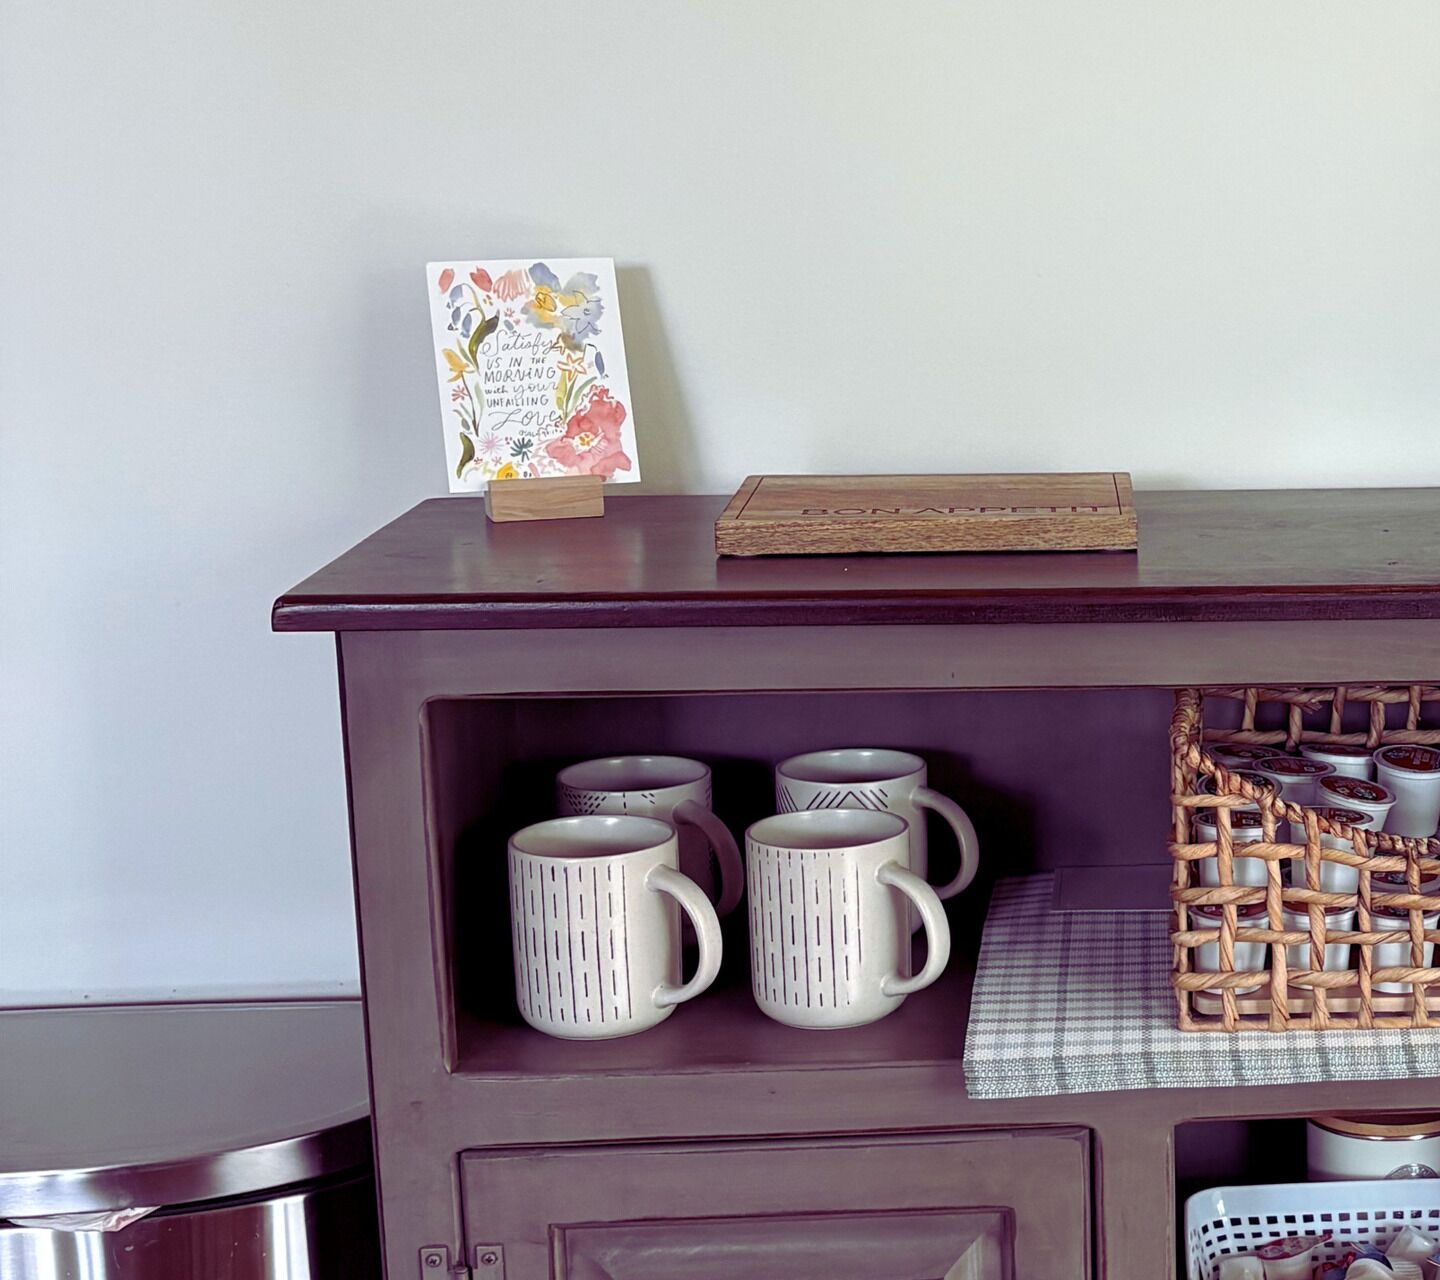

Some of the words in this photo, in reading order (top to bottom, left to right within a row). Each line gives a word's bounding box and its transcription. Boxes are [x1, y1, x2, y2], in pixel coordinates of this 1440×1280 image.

[481, 329, 554, 357] Satisfy
[486, 357, 502, 370] US
[509, 356, 523, 368] IN
[531, 357, 546, 365] THE
[485, 385, 508, 395] with
[513, 381, 558, 401] your
[488, 408, 563, 431] Love
[801, 508, 901, 516] BON
